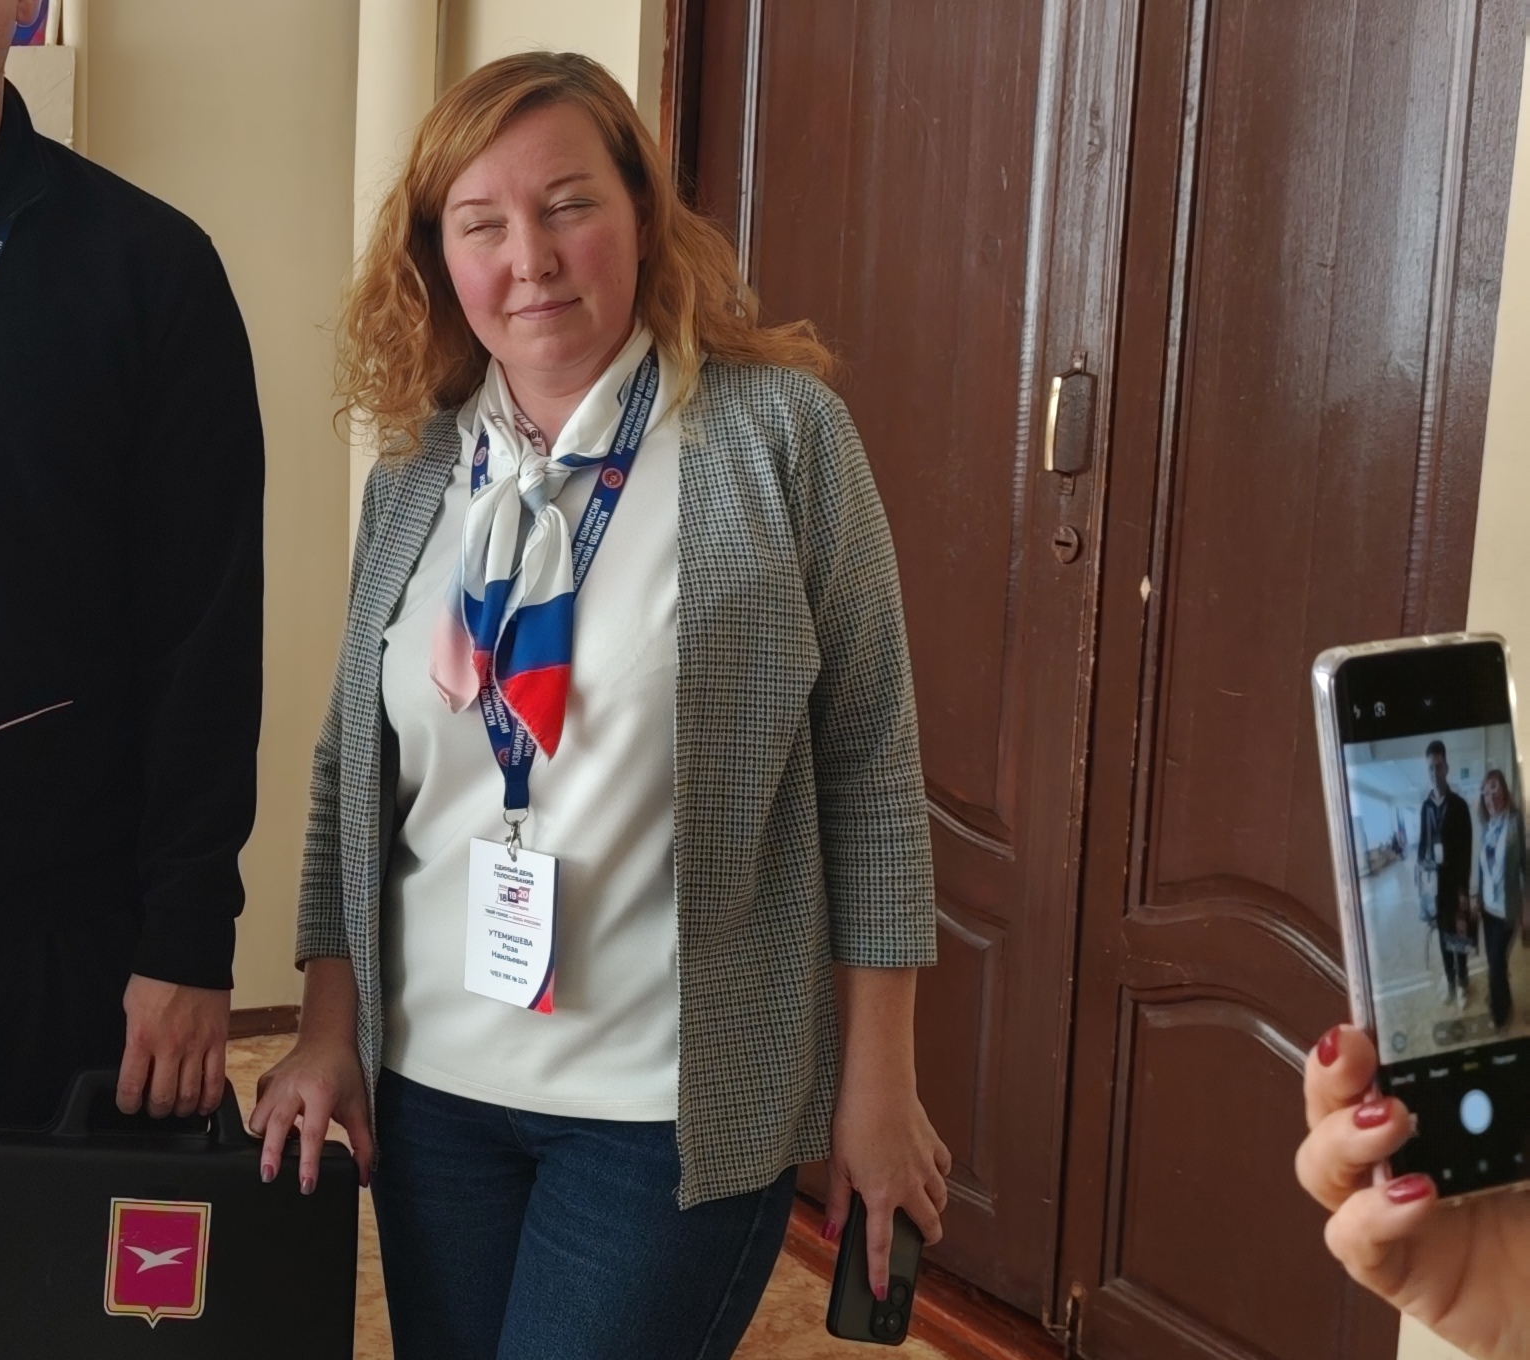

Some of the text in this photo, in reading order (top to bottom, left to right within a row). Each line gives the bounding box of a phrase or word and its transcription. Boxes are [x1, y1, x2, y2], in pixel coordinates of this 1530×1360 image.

[613, 391, 643, 456] ИЗБИРАТЕЛЬНАЯ
[627, 398, 652, 451] МОСКОВСКОЙ
[579, 497, 603, 542] КОМИССИЯ
[590, 510, 610, 546] ОБЛАСТИ
[480, 688, 497, 727] ОБЛАСТИ
[499, 889, 529, 902] 18 19 20
[488, 928, 534, 947] УТЕМИШЕВА
[502, 942, 519, 954] Роза
